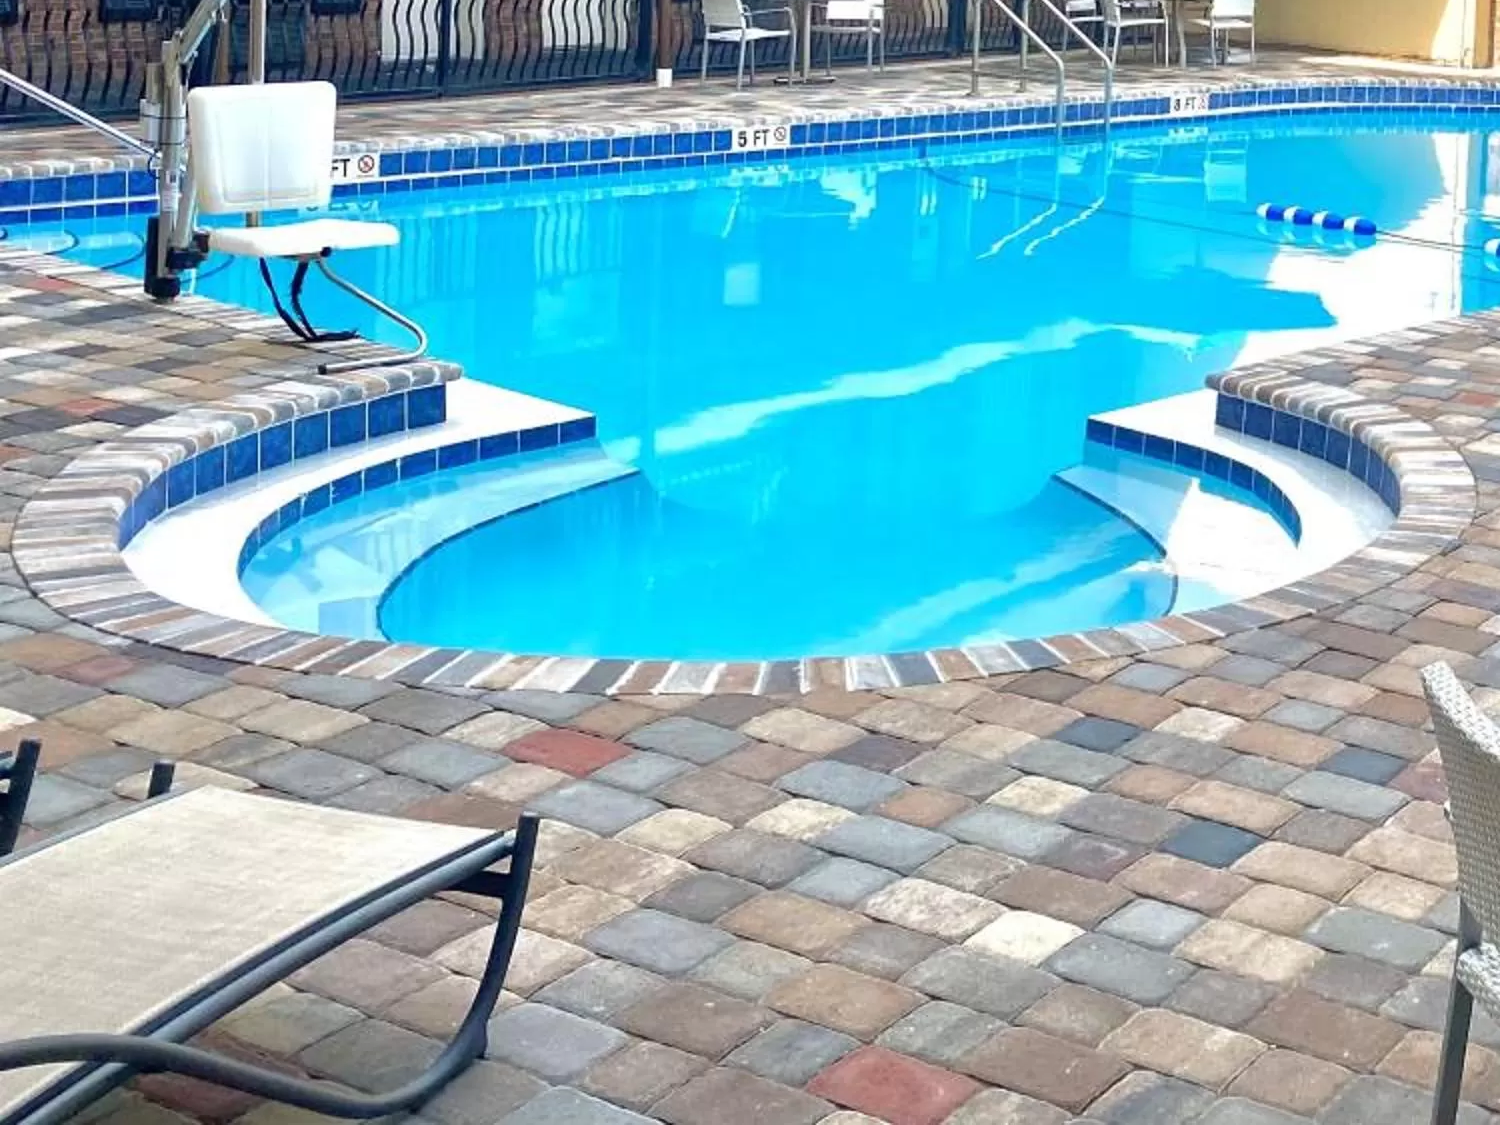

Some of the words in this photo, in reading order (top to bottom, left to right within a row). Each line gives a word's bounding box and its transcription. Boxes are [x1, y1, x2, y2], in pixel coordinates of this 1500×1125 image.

[1185, 97, 1197, 111] FT
[738, 130, 747, 148] 5
[753, 129, 769, 146] FT
